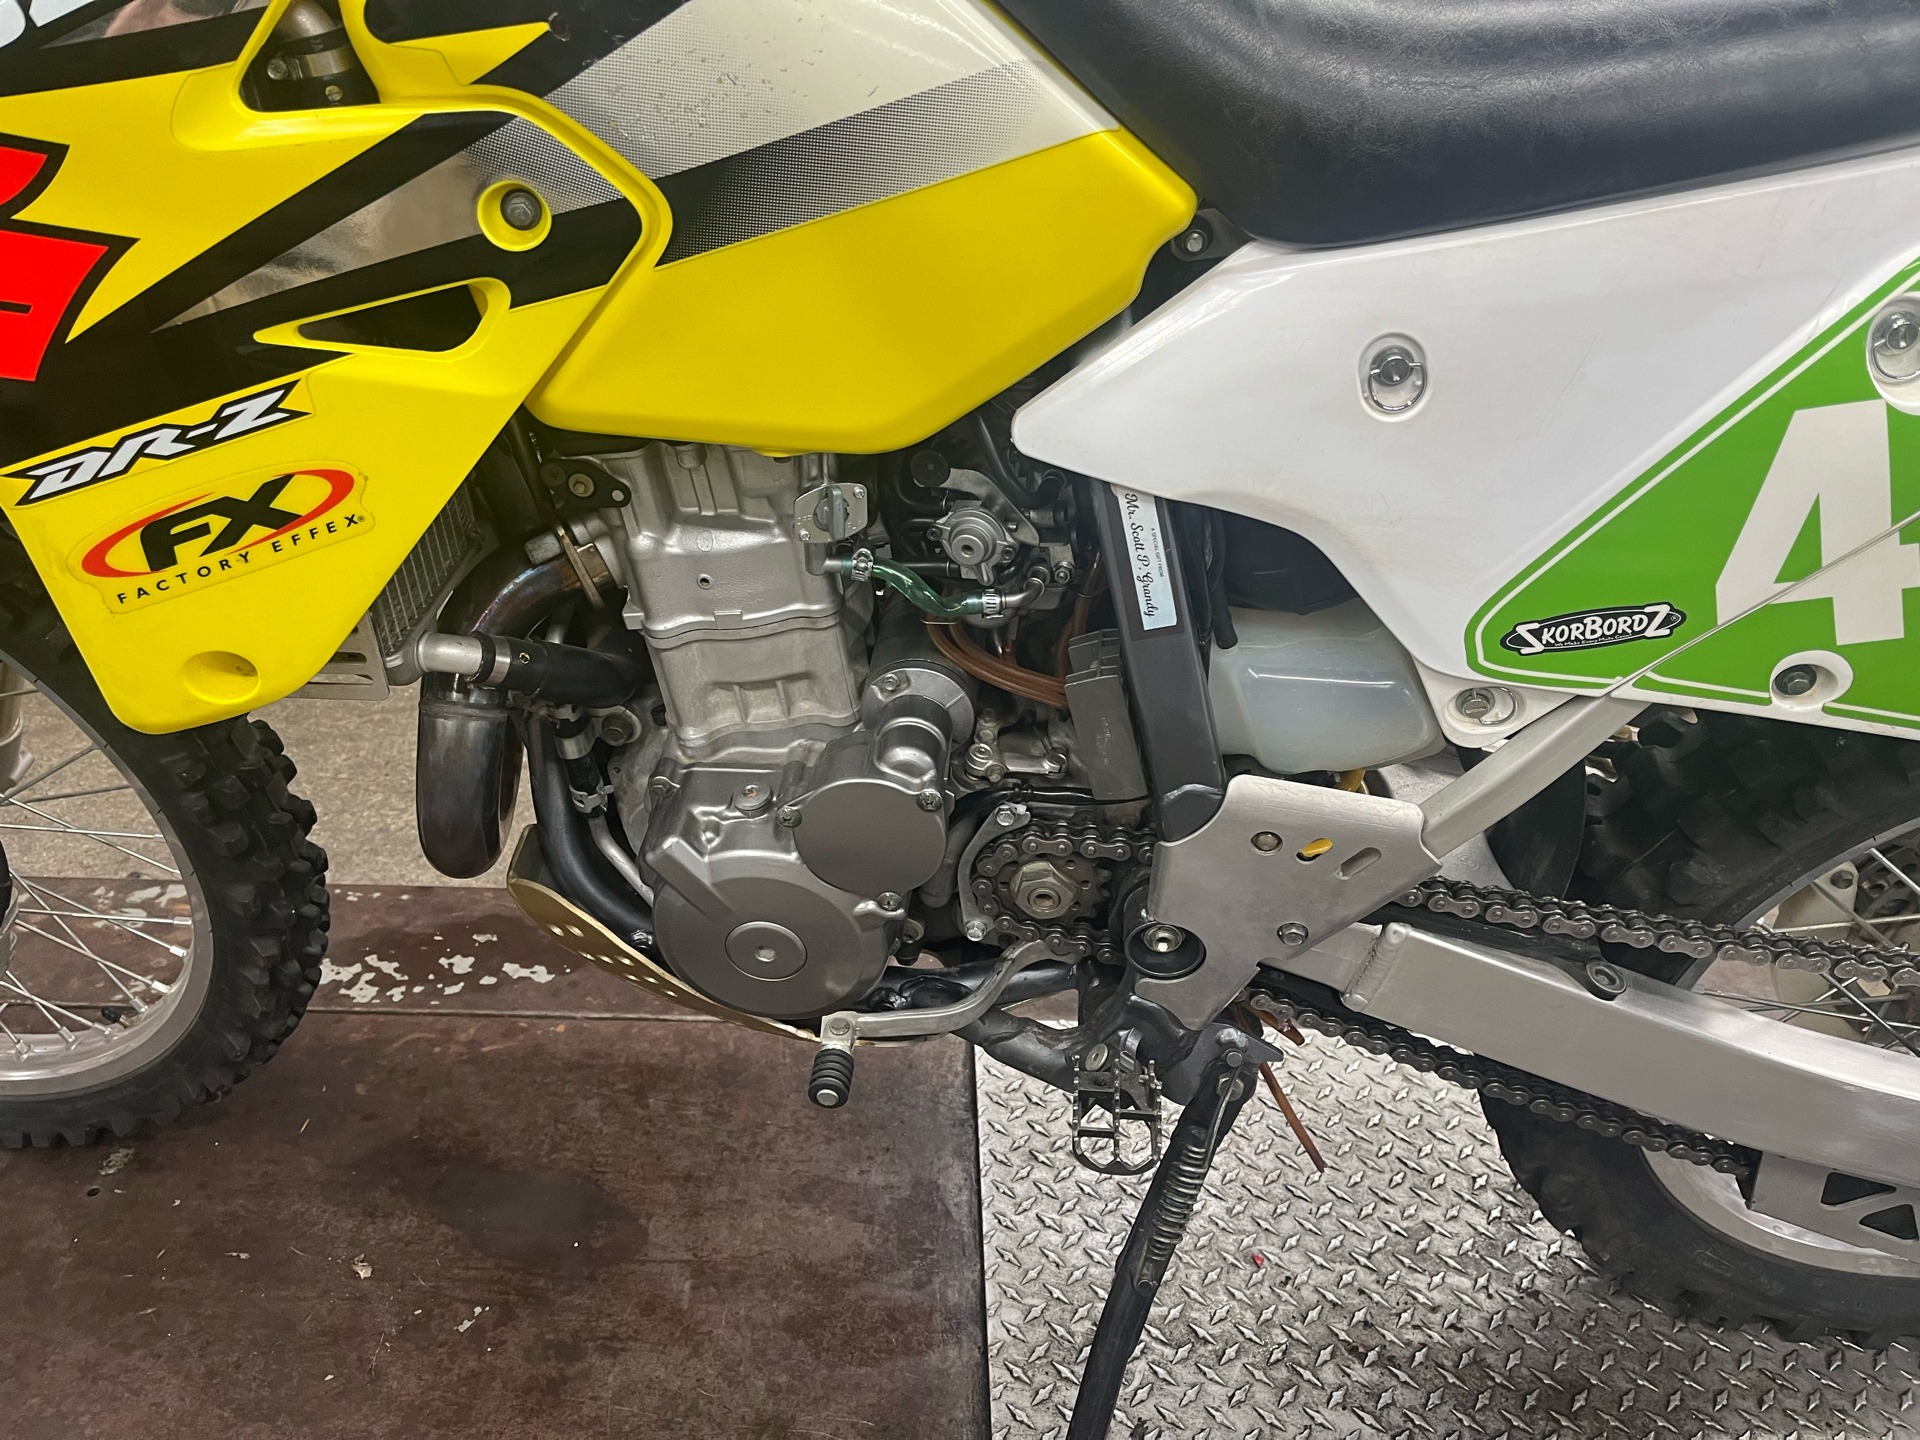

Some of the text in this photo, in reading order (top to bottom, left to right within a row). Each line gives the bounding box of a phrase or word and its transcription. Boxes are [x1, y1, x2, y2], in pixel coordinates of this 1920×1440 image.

[26, 389, 290, 500] DR-Z
[140, 474, 304, 572] FX
[1124, 493, 1140, 519] Mr.
[1130, 522, 1145, 552] Scott
[117, 551, 250, 604] FACTORY
[1136, 572, 1159, 618] Grandy
